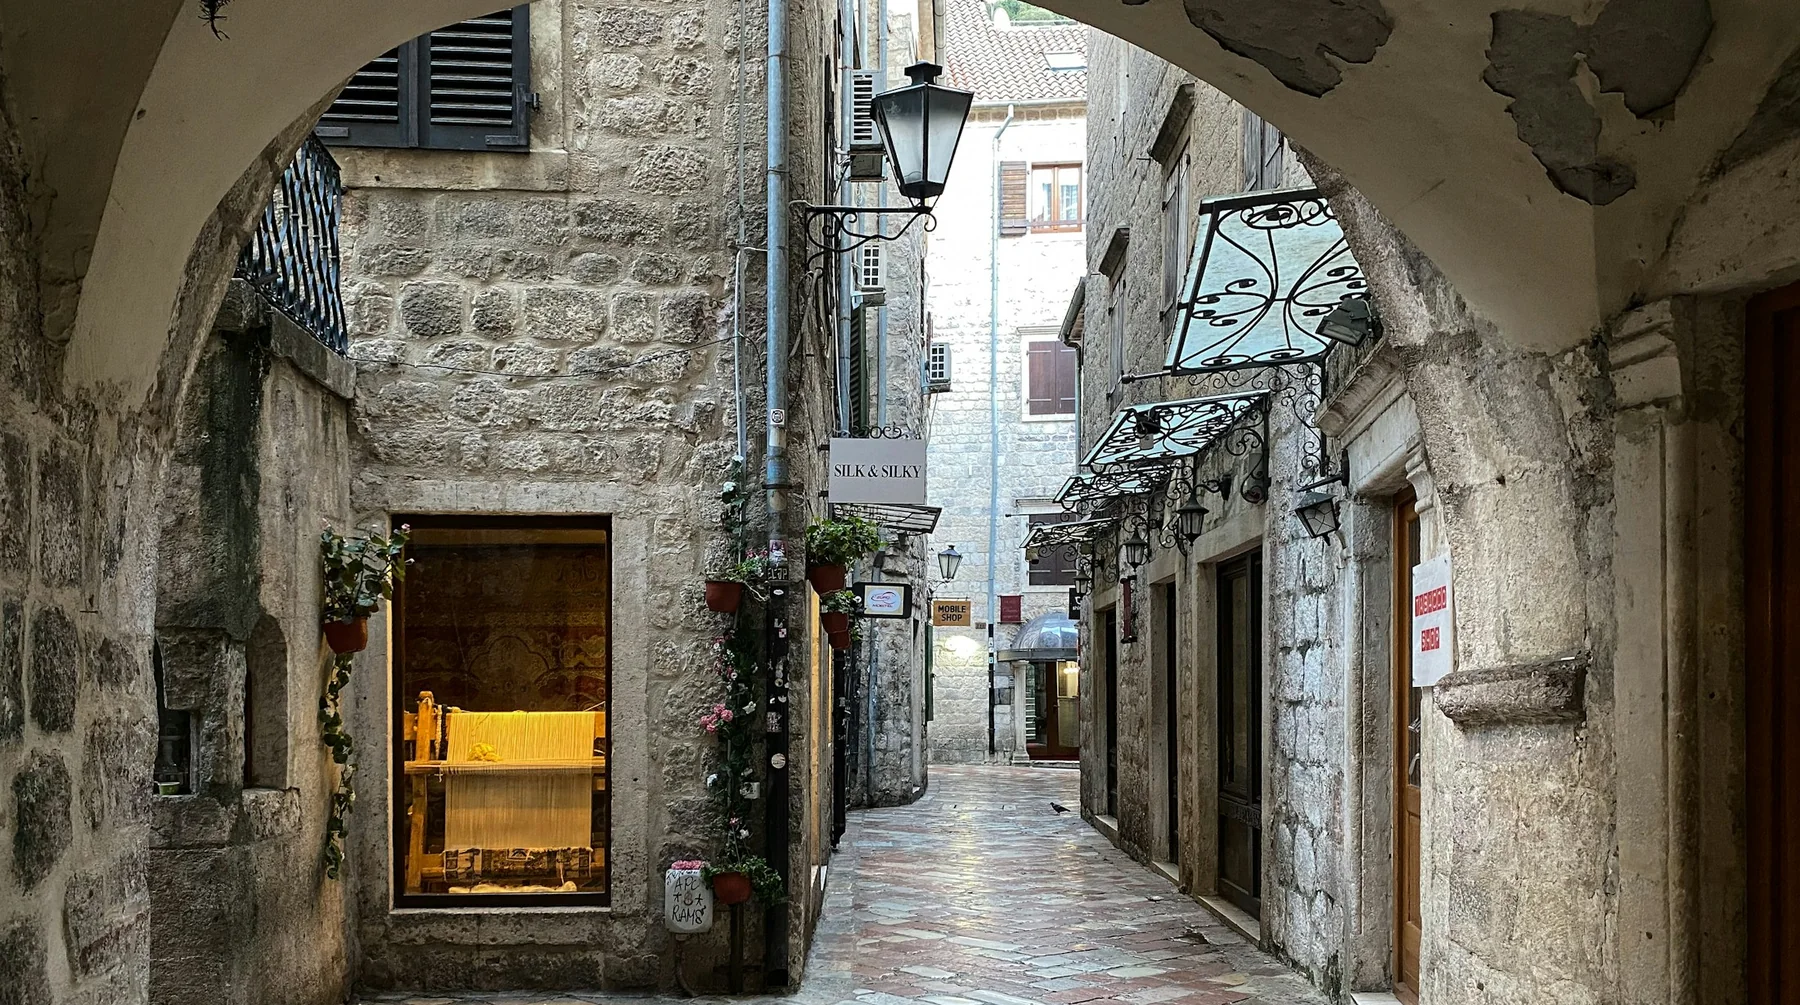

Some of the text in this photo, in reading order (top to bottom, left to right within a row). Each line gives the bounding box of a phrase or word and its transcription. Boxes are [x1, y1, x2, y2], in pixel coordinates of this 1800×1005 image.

[834, 463, 922, 478] SILK & SILKY
[937, 605, 966, 613] MOBILE
[941, 613, 962, 622] SHOP
